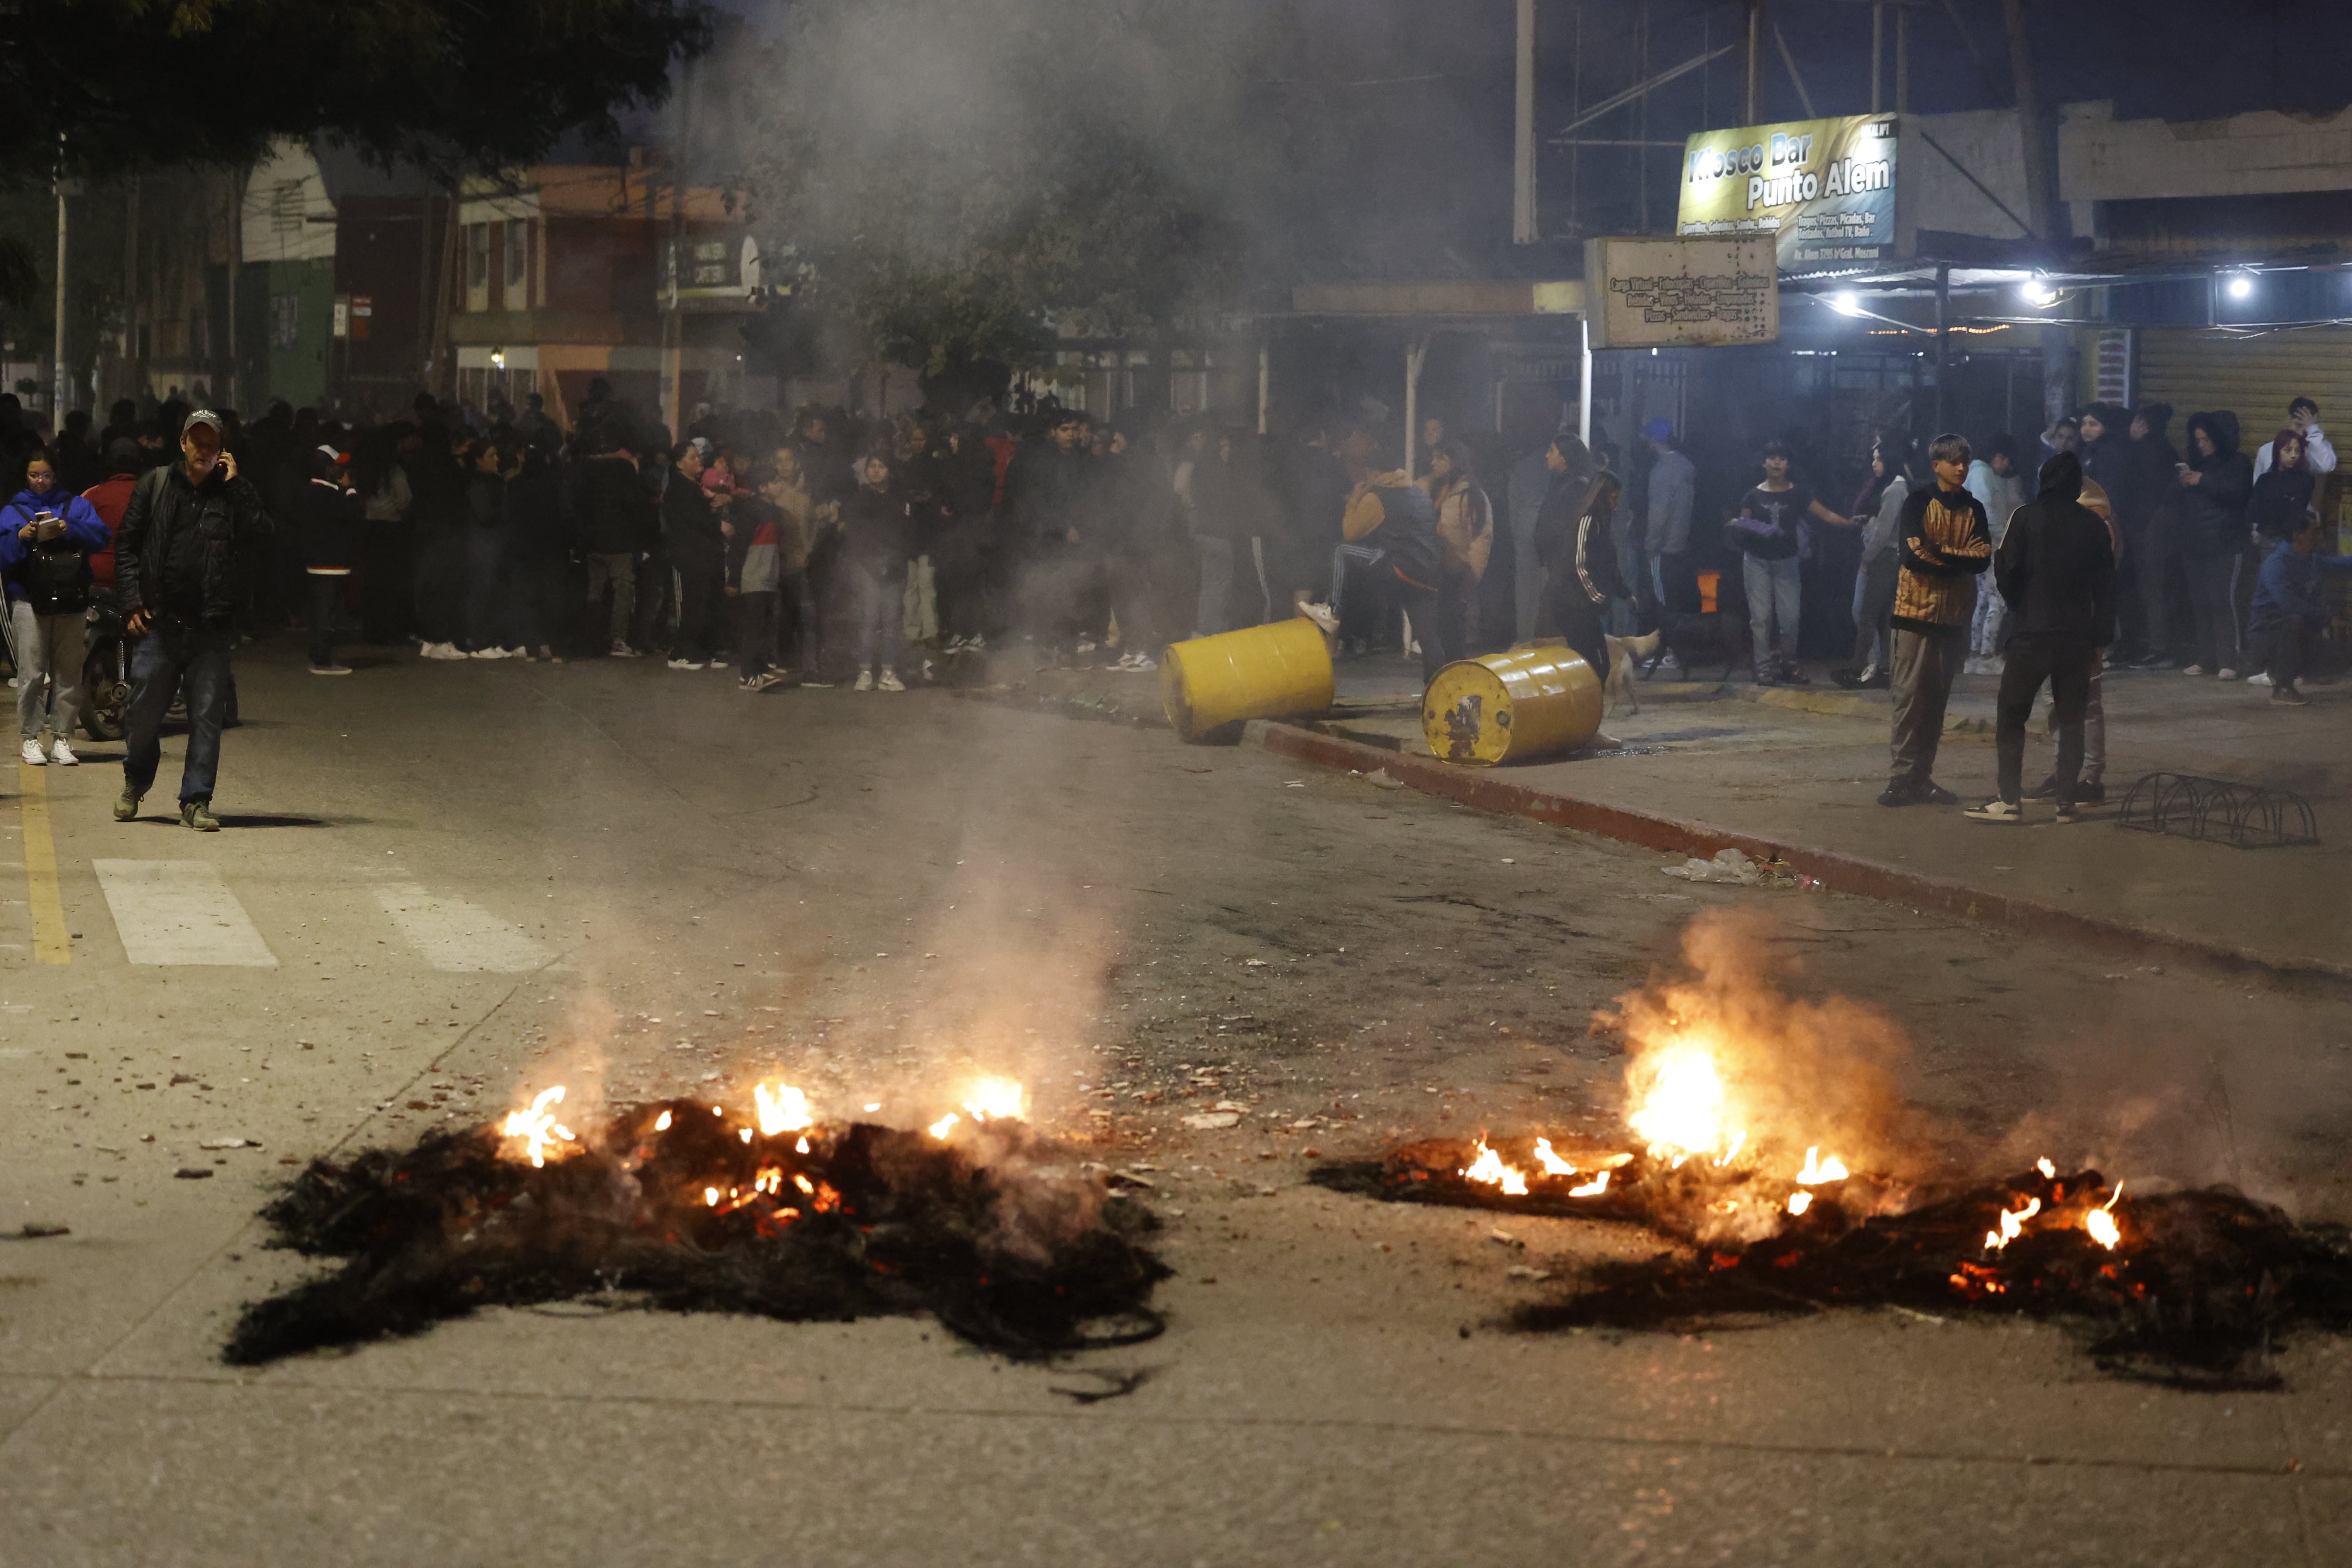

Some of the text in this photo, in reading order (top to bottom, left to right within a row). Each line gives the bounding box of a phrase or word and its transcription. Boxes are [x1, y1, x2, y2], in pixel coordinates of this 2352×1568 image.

[1689, 133, 1813, 184] Kiosco Bar
[1747, 158, 1890, 210] Punto Alem
[1865, 212, 1875, 224] Bar
